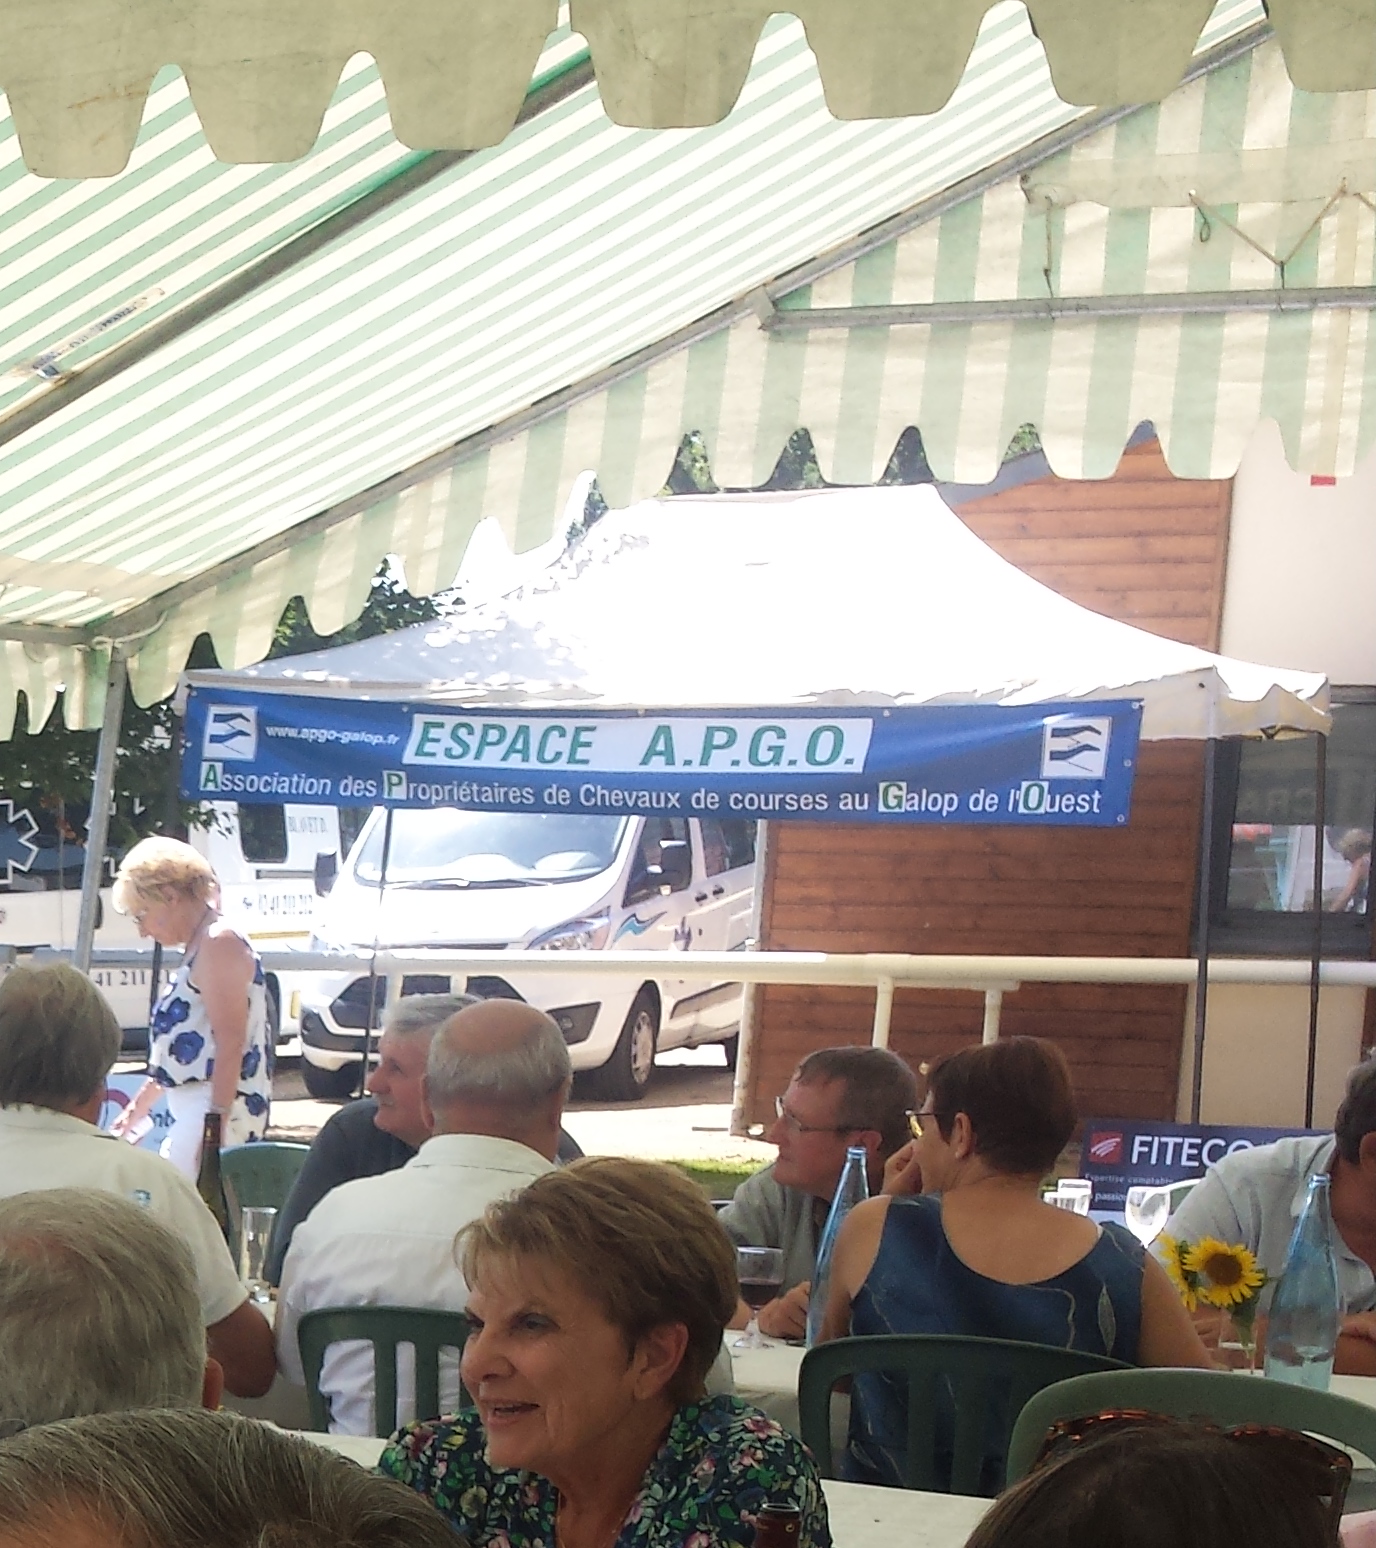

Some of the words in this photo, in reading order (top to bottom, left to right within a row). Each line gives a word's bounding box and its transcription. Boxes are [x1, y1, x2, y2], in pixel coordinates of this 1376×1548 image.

[265, 725, 400, 746] www.apgo-galop.fr
[414, 721, 597, 765] ESPACE
[639, 724, 855, 766] A.P.G.O.
[202, 763, 332, 796] Association
[338, 775, 378, 798] des
[386, 772, 535, 806] Propriétaires
[543, 784, 571, 806] de
[578, 783, 681, 809] Chevaux
[690, 788, 720, 810] de
[729, 791, 829, 812] courses
[838, 793, 869, 811] au
[882, 783, 959, 817] Galop
[968, 788, 999, 813] de
[1007, 783, 1102, 814] l'Ouest
